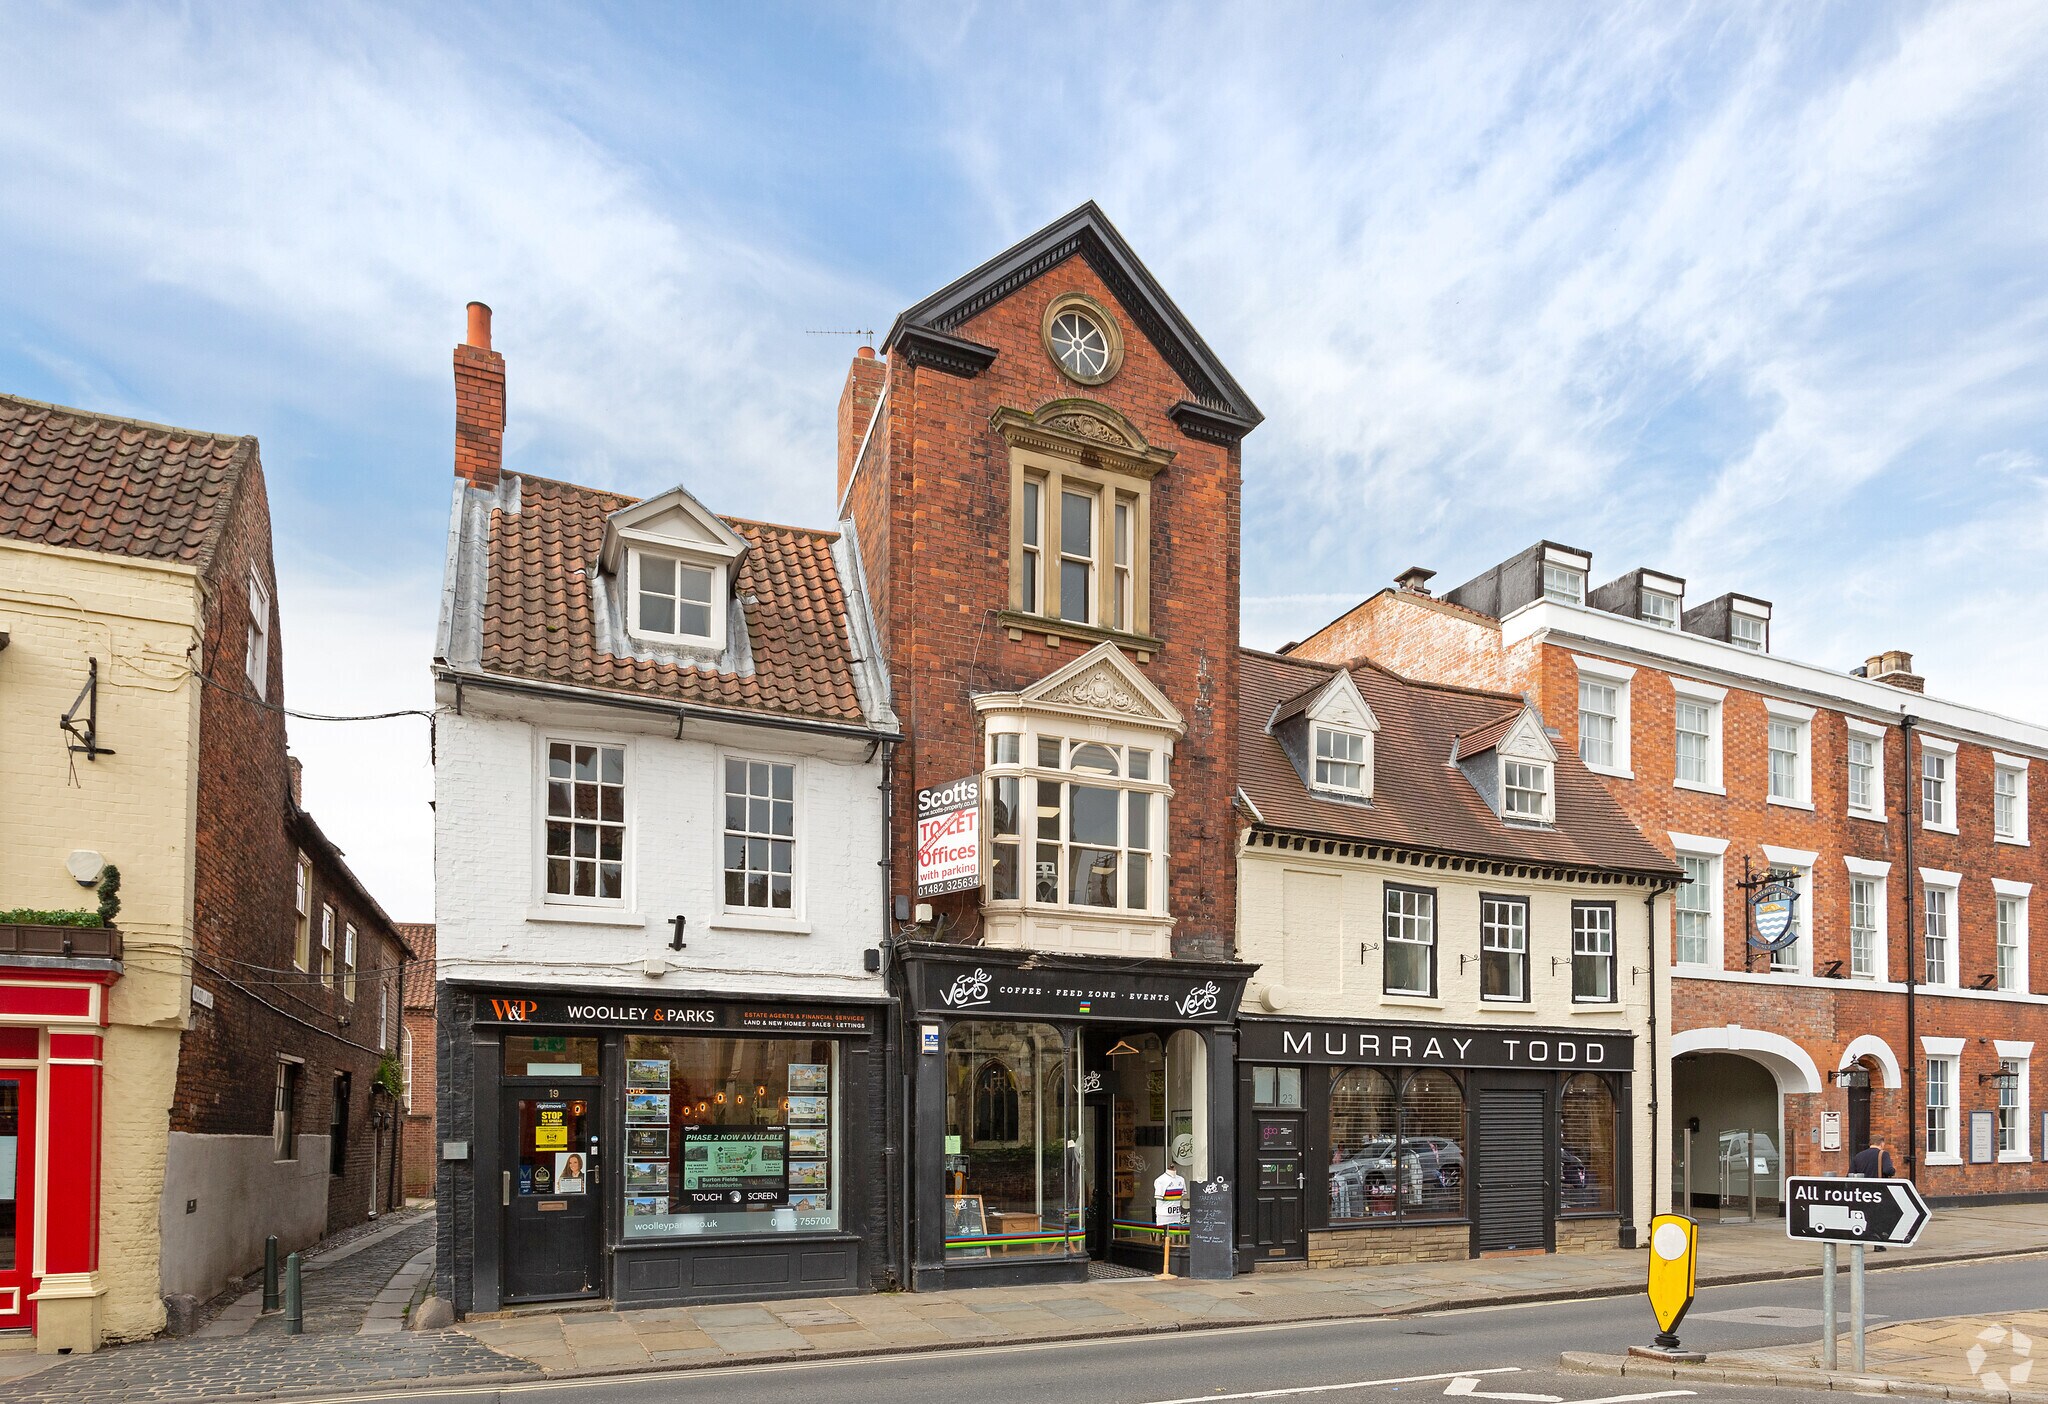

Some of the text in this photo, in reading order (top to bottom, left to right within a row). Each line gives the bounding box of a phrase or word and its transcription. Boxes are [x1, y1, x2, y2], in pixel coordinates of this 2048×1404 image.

[918, 781, 978, 811] Scotts
[918, 799, 978, 818] www.scotts-property.co.uk
[920, 812, 977, 842] TO LET
[920, 844, 976, 868] Offices
[920, 863, 976, 881] with parking
[918, 876, 979, 896] 01482 325634
[999, 986, 1170, 1001] COFFEE FEED ZONE EVENTS
[491, 1000, 538, 1021] W&P
[567, 1005, 715, 1023] WOOLLEY & PARKS
[1283, 1031, 1604, 1063] MURRAY TODD
[548, 1089, 559, 1098] 19
[541, 1111, 563, 1120] STOP
[692, 1192, 778, 1201] TOUCH SCREEN
[1795, 1186, 1882, 1203] All routes
[1167, 1206, 1181, 1214] OPE
[634, 1219, 718, 1232] woolleyparko.uk
[800, 1216, 831, 1226] 755700
